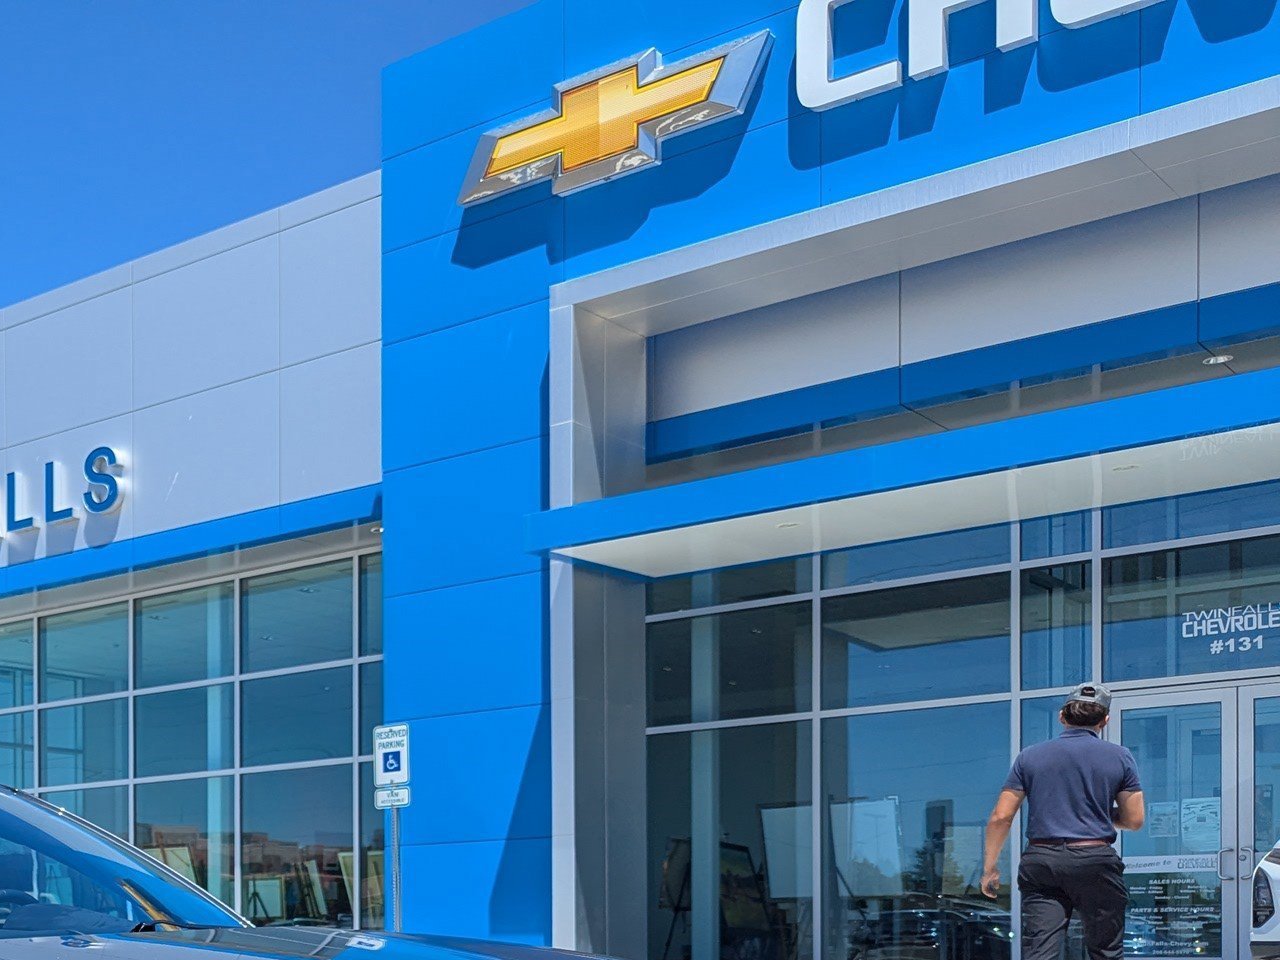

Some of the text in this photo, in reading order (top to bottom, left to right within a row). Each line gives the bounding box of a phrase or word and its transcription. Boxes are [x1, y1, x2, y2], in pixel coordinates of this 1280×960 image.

[796, 0, 1166, 112] CH
[1182, 602, 1280, 622] TWINFALL
[1182, 611, 1280, 638] CHEVROLE
[1210, 635, 1263, 655] #131
[376, 730, 406, 739] RESERVED
[378, 740, 405, 749] PARKING
